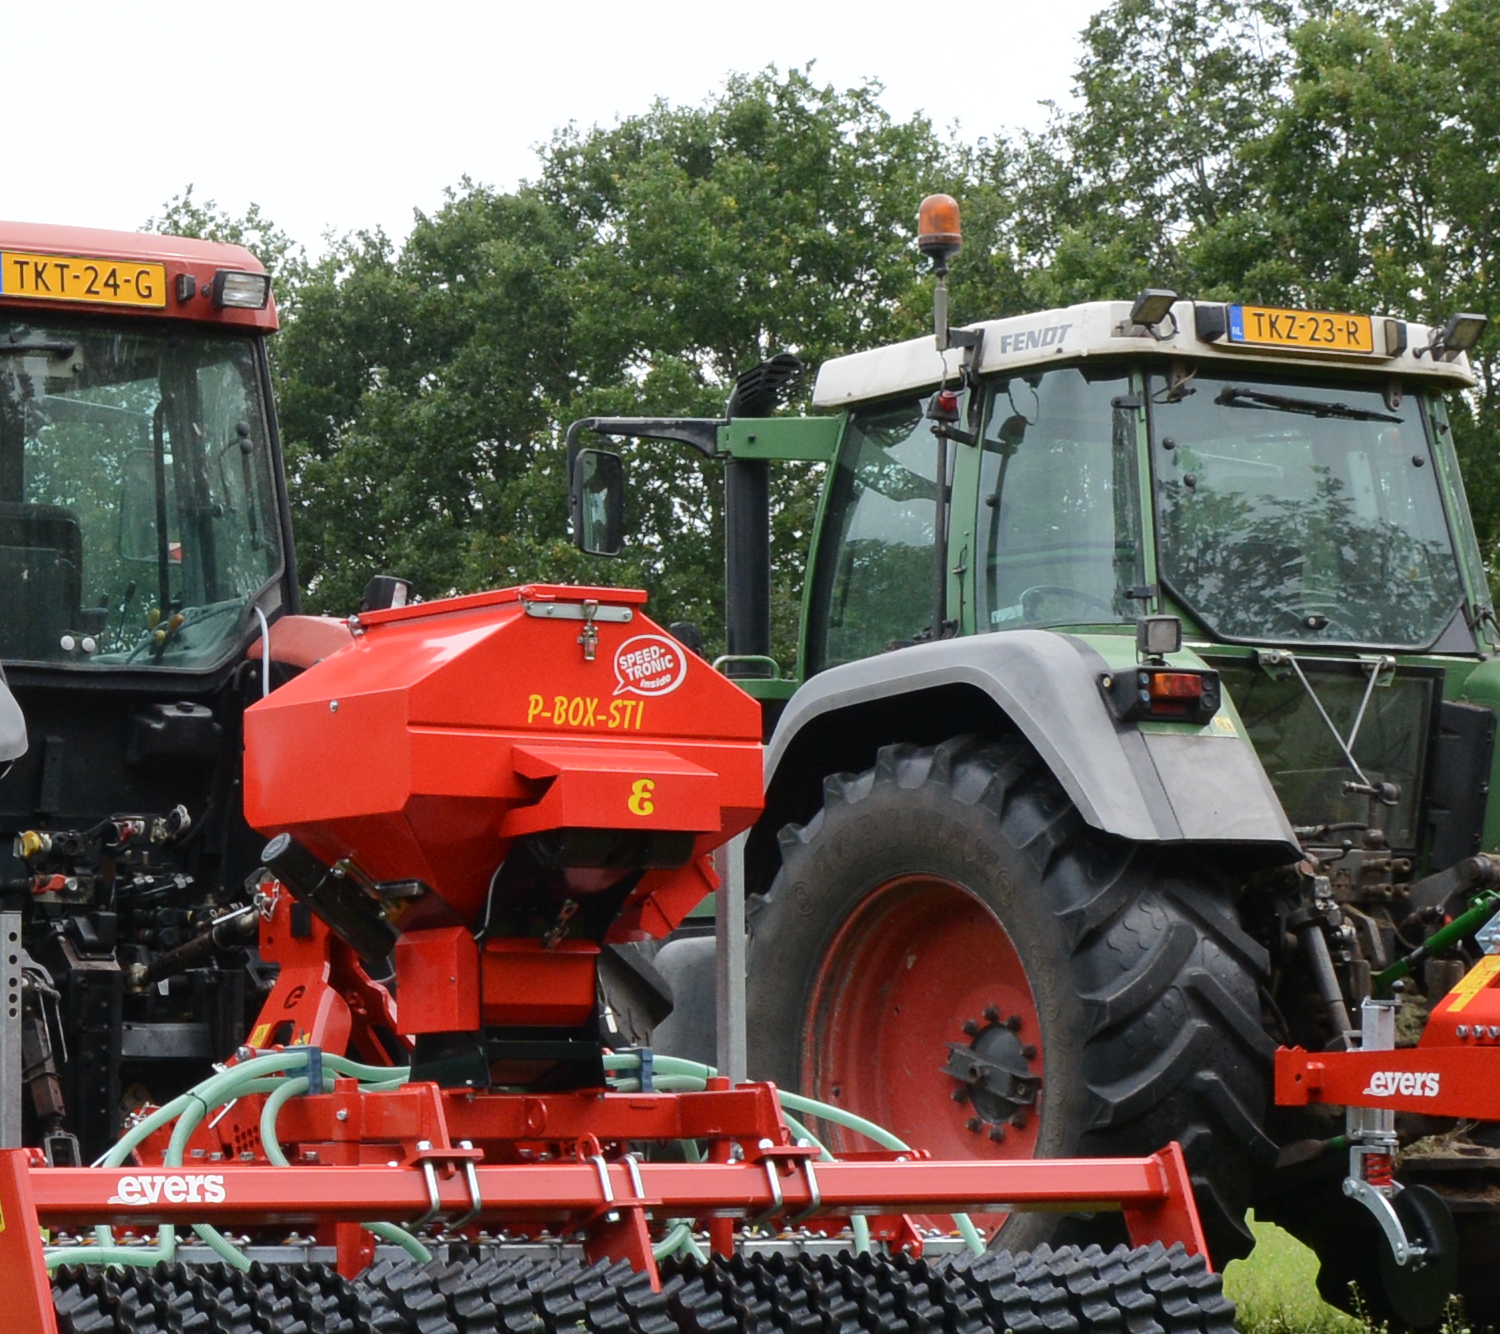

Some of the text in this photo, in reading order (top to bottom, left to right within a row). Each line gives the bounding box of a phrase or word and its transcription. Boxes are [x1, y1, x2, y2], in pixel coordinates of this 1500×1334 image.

[13, 259, 153, 299] TKT-24-G
[1000, 323, 1074, 355] FENDT
[1252, 312, 1361, 345] TKZ-23-R
[618, 645, 666, 670] SPEED-
[625, 654, 675, 681] TRONIC
[527, 694, 645, 730] P-BOX-STI
[1367, 1071, 1440, 1097] evers
[114, 1174, 226, 1204] evers
